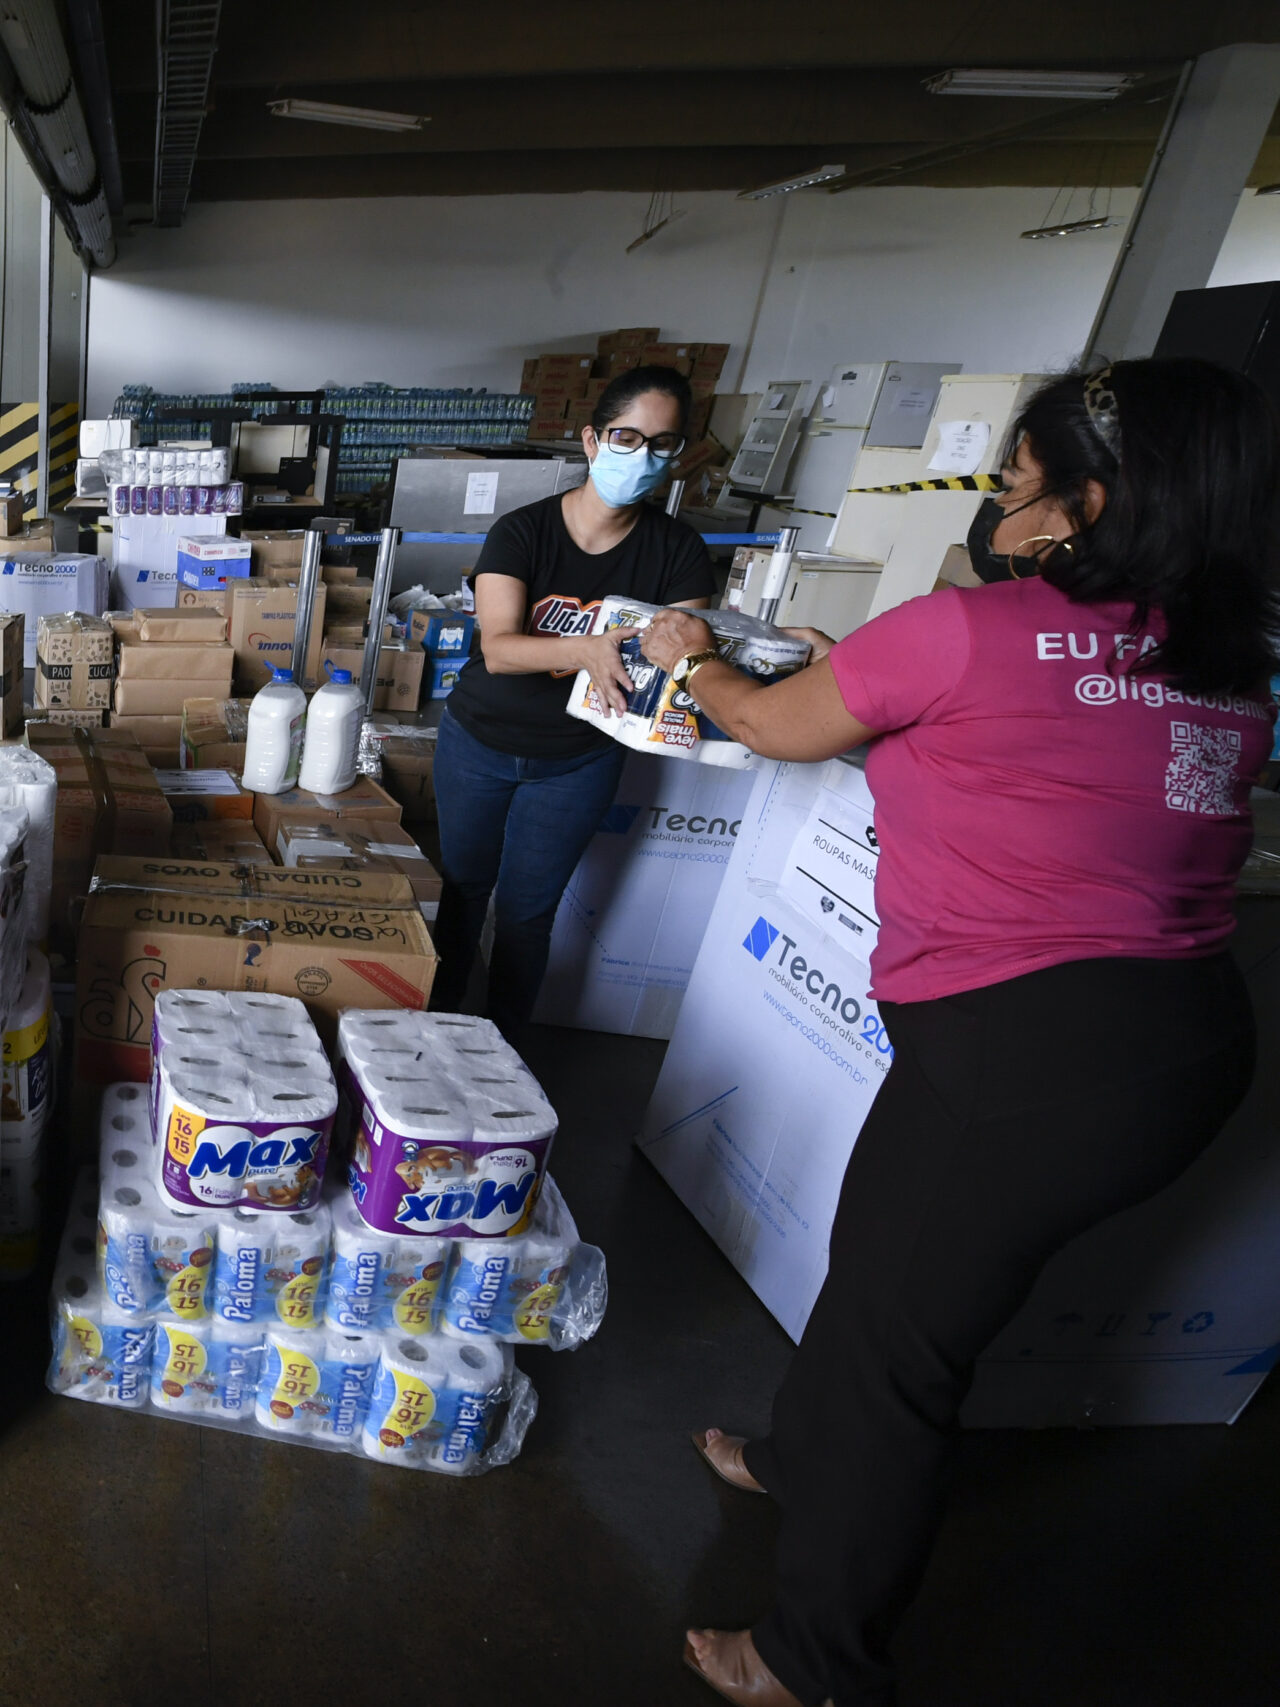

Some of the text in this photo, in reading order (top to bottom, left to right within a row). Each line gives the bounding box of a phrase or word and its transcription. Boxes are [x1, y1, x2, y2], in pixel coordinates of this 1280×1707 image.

[344, 535, 369, 544] SENADO
[538, 601, 593, 636] LIGA
[1036, 632, 1099, 661] EU
[656, 722, 695, 737] mais
[664, 733, 695, 750] leve
[640, 831, 695, 844] mobiliário
[813, 834, 851, 867] ROUPAS
[143, 863, 221, 879] OVOS
[134, 907, 278, 935] CUIDAO
[777, 933, 895, 1062] Tecno20
[768, 967, 808, 1005] mobiliário
[809, 1004, 863, 1051] corporativo
[865, 1050, 873, 1058] e
[762, 989, 869, 1086] www.tecno2000.com.br
[176, 1117, 193, 1136] 16
[172, 1136, 190, 1155] 15
[186, 1131, 323, 1180] Max
[514, 1156, 528, 1169] 16
[247, 1166, 277, 1177] pure
[199, 1184, 213, 1195] 16
[394, 1170, 538, 1223] Max
[175, 1278, 204, 1292] 16
[223, 1247, 258, 1322] Paloma
[339, 1252, 379, 1328] Paloma
[287, 1286, 314, 1302] 16
[402, 1291, 432, 1309] 16
[459, 1256, 508, 1333] Paloma
[175, 1296, 200, 1310] 15
[524, 1294, 554, 1312] 16
[283, 1305, 311, 1319] 15
[400, 1309, 429, 1324] 15
[519, 1315, 548, 1328] 15
[174, 1343, 199, 1358] 15
[172, 1360, 200, 1375] 16
[286, 1363, 312, 1378] 15
[282, 1380, 312, 1397] 16
[335, 1366, 370, 1437] Paloma
[401, 1389, 429, 1406] 15
[394, 1408, 427, 1427] 16
